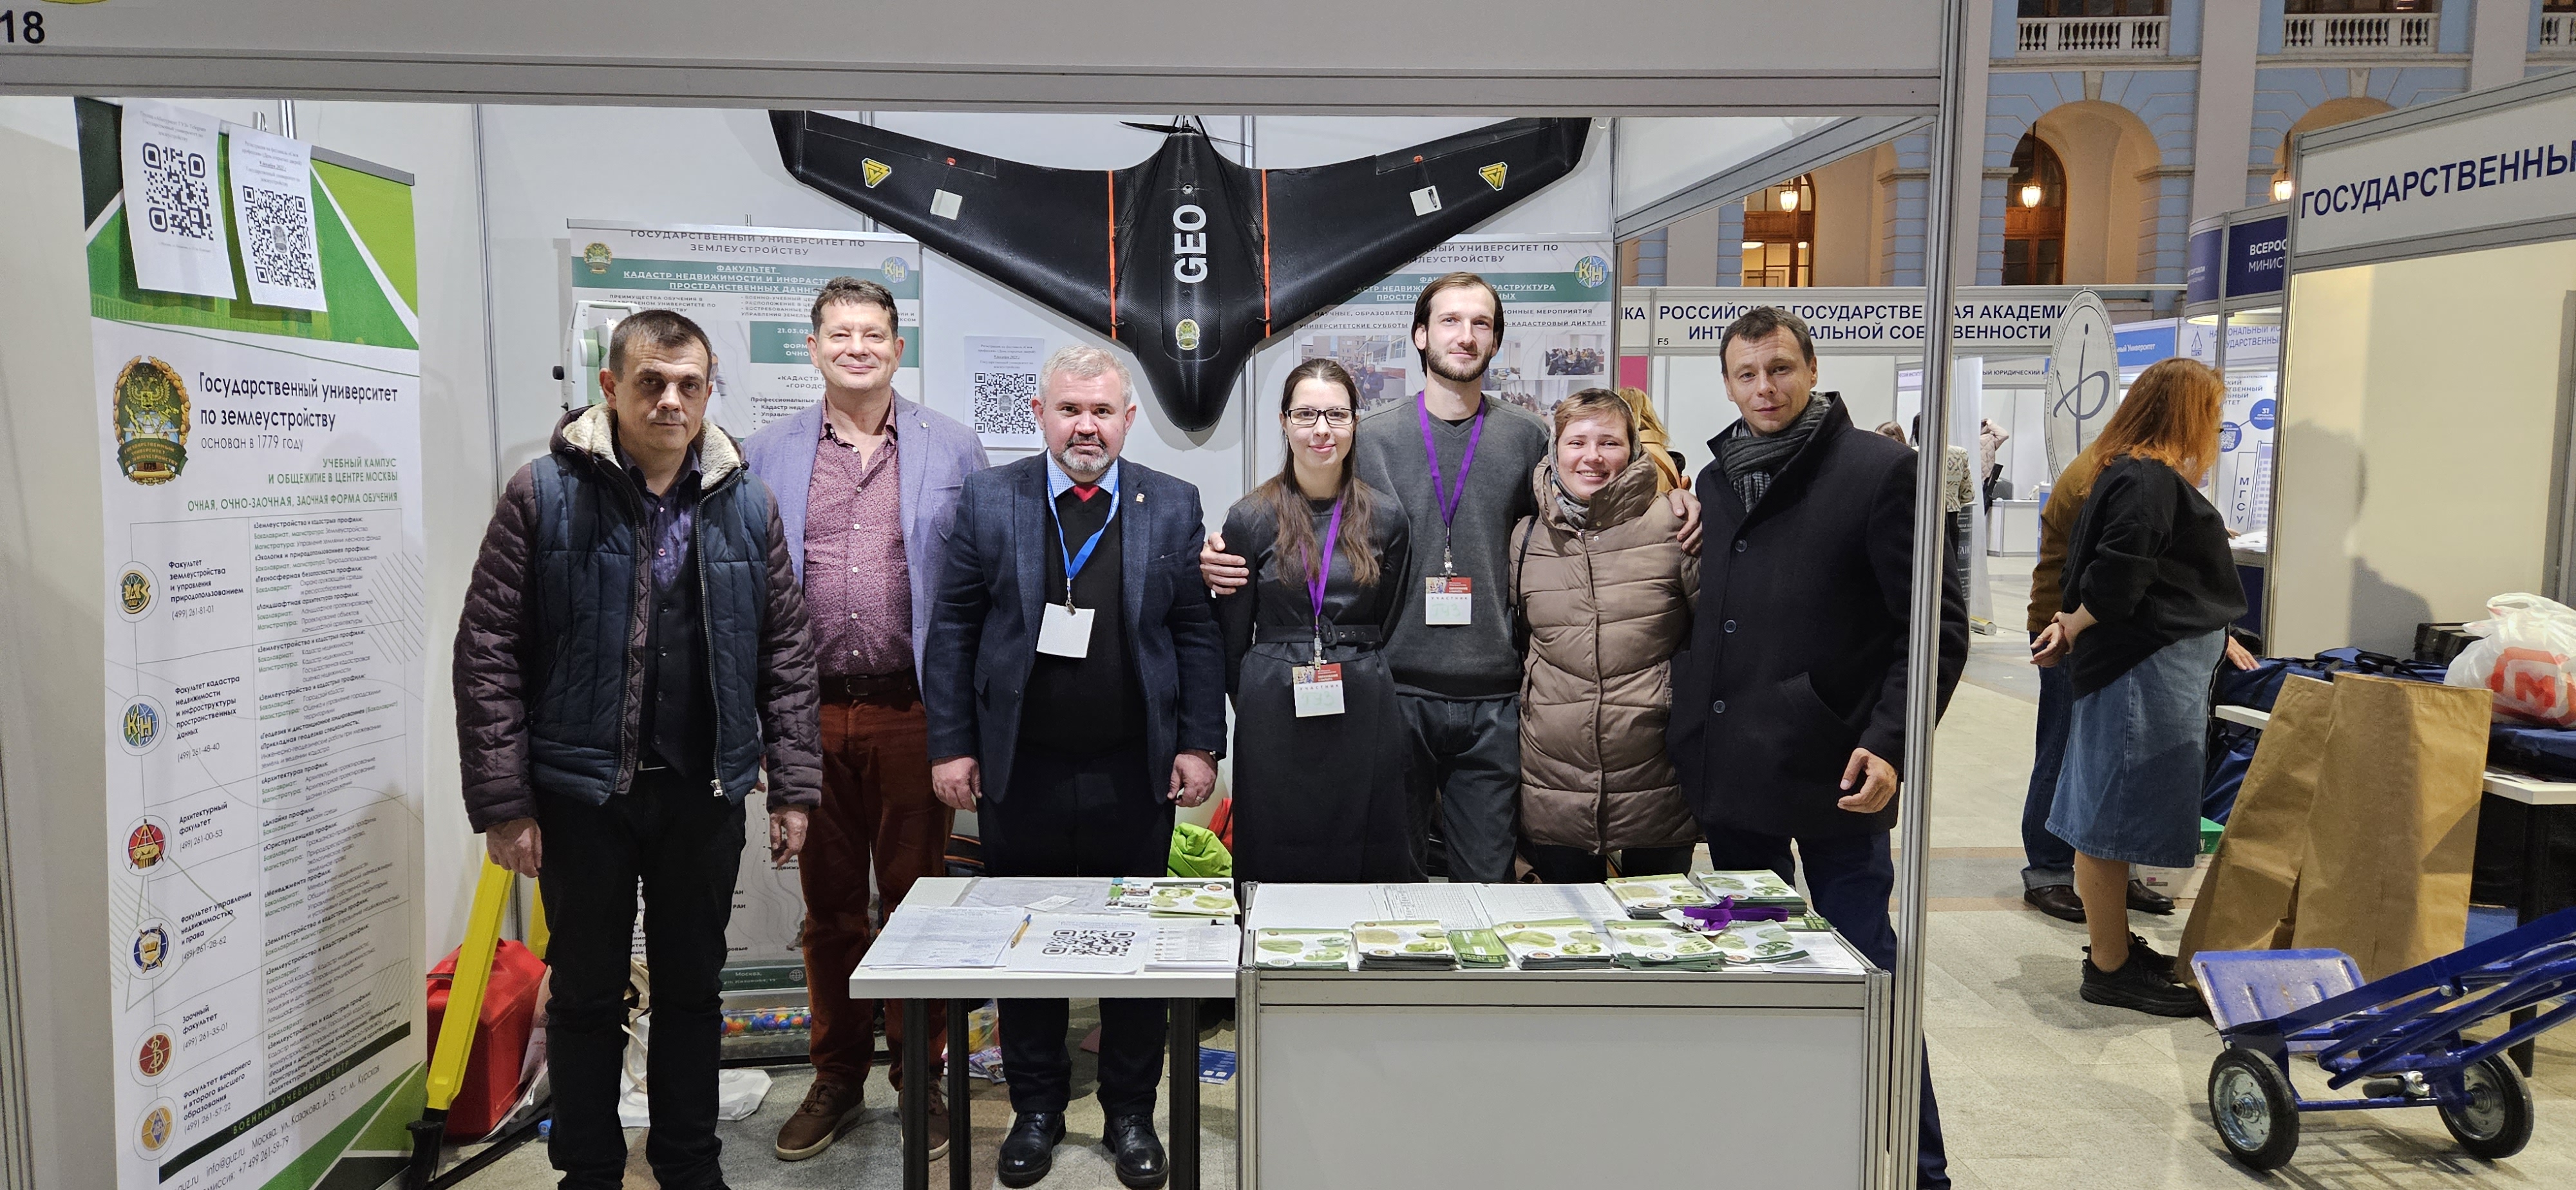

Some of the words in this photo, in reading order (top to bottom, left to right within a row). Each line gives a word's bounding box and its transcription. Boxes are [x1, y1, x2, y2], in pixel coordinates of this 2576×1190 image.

[0, 10, 45, 44] 18
[690, 243, 809, 256] ЗЕМЛЕУСТРОЙСТВУ
[761, 235, 844, 247] УНИВЕРСИТЕТ
[1173, 204, 1208, 283] GEO
[623, 270, 672, 279] КАДАСТР
[676, 272, 762, 282] НЕДВИЖИМОСТИ
[716, 265, 777, 274] ФАКУЛЬТЕТ
[884, 261, 905, 279] КН
[1578, 261, 1603, 282] КН
[669, 282, 779, 292] ПРОСТРАНСТВЕННЫХ
[1660, 302, 1786, 320] РОССИЙС
[1792, 305, 1973, 322] ГОСУДАРСТВЕАЯ
[2209, 326, 2268, 338] НАОНАЛЬНЫЙ
[2127, 343, 2156, 352] Университет
[2213, 335, 2279, 350] ГУДАРСТВЕННЫ
[199, 372, 318, 400] Государственный
[321, 382, 398, 404] университет
[200, 409, 216, 425] по
[221, 407, 336, 431] землеустройству
[201, 437, 246, 449] основан
[249, 437, 254, 449] в
[258, 435, 278, 449] 1779
[282, 437, 304, 452] году
[323, 456, 363, 469] УЧЕБНЫЙ
[364, 457, 397, 468] КАМПУС
[268, 475, 275, 484] И
[277, 473, 326, 486] ОБЩЕЖИТИЕ
[328, 473, 333, 483] В
[335, 472, 365, 484] ЦЕНТРЕ
[366, 471, 398, 482] МОСКВЫ
[187, 500, 218, 513] ОЧНАЯ,
[220, 495, 294, 511] ОЧНО-ЗАОЧНАЯ,
[296, 494, 329, 507] ЗАОЧНАЯ
[330, 493, 361, 505] ФОРМА
[362, 491, 398, 503] ОБУЧЕНИЯ
[2237, 477, 2249, 524] МГСУ
[169, 560, 202, 569] Факультет
[170, 568, 226, 580] землеустройства
[171, 588, 244, 603] природопользованием
[177, 581, 211, 592] управления
[173, 610, 187, 621] (499)
[189, 605, 214, 617] 261-81-01
[175, 683, 205, 694] Факультет
[207, 676, 240, 687] кадастра
[176, 690, 221, 706] недвижимости
[182, 698, 236, 715] инфраструктуры
[127, 712, 153, 738] КН
[176, 708, 237, 729] пространственных
[176, 728, 198, 740] данных
[178, 751, 191, 762] (499)
[193, 742, 220, 757] 261-48-40
[179, 801, 227, 824] Архитектурный
[179, 818, 211, 835] факультет
[180, 840, 193, 853] (499)
[194, 829, 223, 845] 261-00-53
[181, 906, 213, 923] Факультет
[214, 891, 252, 912] управления
[181, 910, 233, 935] недвижимостью
[186, 930, 205, 943] права
[196, 936, 227, 954] 261-28-62
[183, 1005, 210, 1024] Заочный
[183, 1013, 218, 1035] факультет
[183, 1036, 198, 1052] (499)
[200, 1022, 228, 1042] 261-35-01
[184, 1079, 218, 1099] Факультет
[220, 1060, 251, 1081] вечернего
[189, 1090, 216, 1108] второго
[217, 1073, 245, 1093] высшего
[232, 1101, 276, 1135] ВОЕННЫЙ
[281, 1076, 321, 1106] УЧЕБНЫЙ
[325, 1062, 349, 1081] ЦЕНТР
[184, 1094, 227, 1121] образования
[184, 1120, 200, 1135] (499)
[202, 1102, 231, 1124] 261-57-22
[206, 1148, 245, 1176] info@guz.ru
[239, 1162, 246, 1173] +7
[248, 1154, 260, 1169] 499
[261, 1136, 289, 1162] 261-59-79
